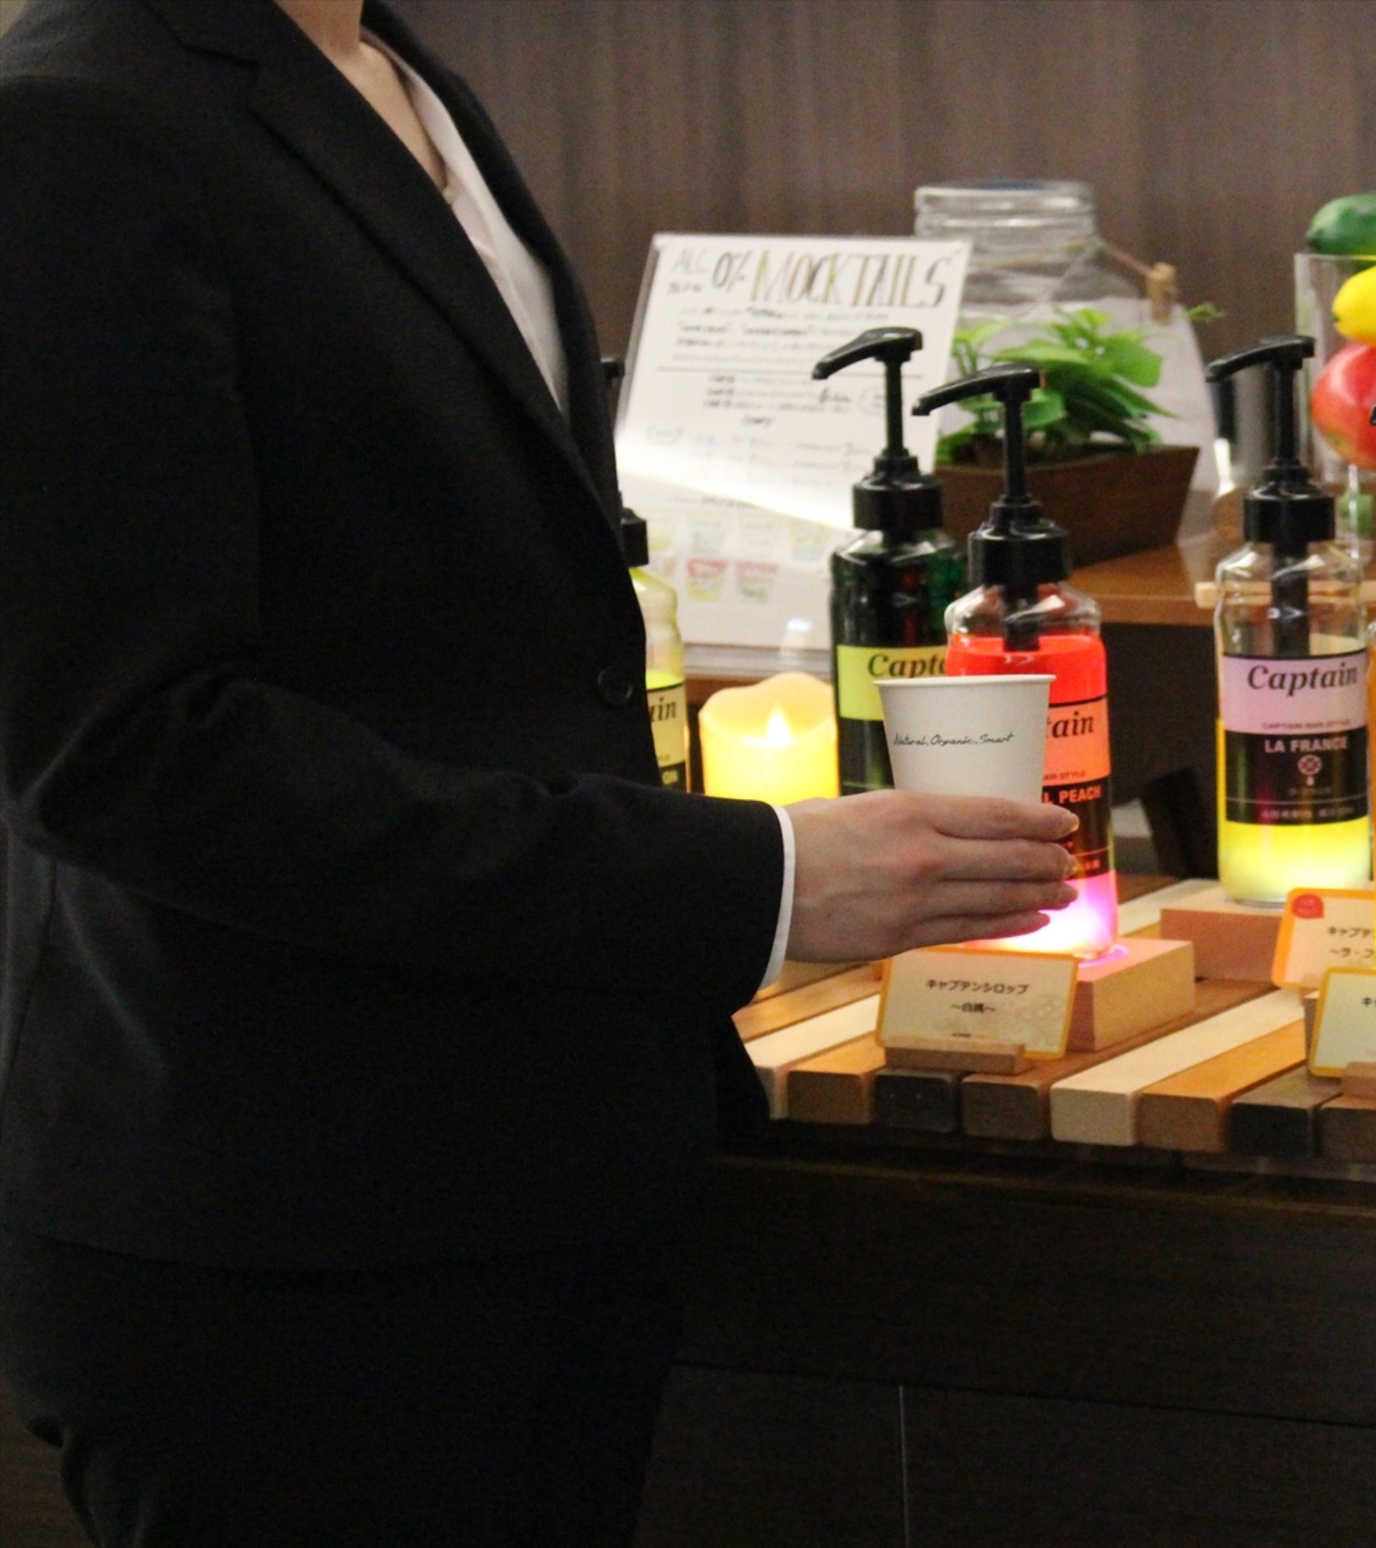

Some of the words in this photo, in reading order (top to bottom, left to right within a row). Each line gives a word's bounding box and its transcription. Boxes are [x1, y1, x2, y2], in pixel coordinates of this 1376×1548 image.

[750, 248, 953, 308] MOCKTAILS
[868, 653, 946, 679] Capt
[1247, 662, 1358, 697] Captain
[979, 731, 1015, 746] Smart
[1264, 739, 1286, 753] LA
[1290, 736, 1348, 753] FRANCE
[1058, 784, 1103, 805] PEACH
[926, 979, 1030, 995] キャプテンシロップ
